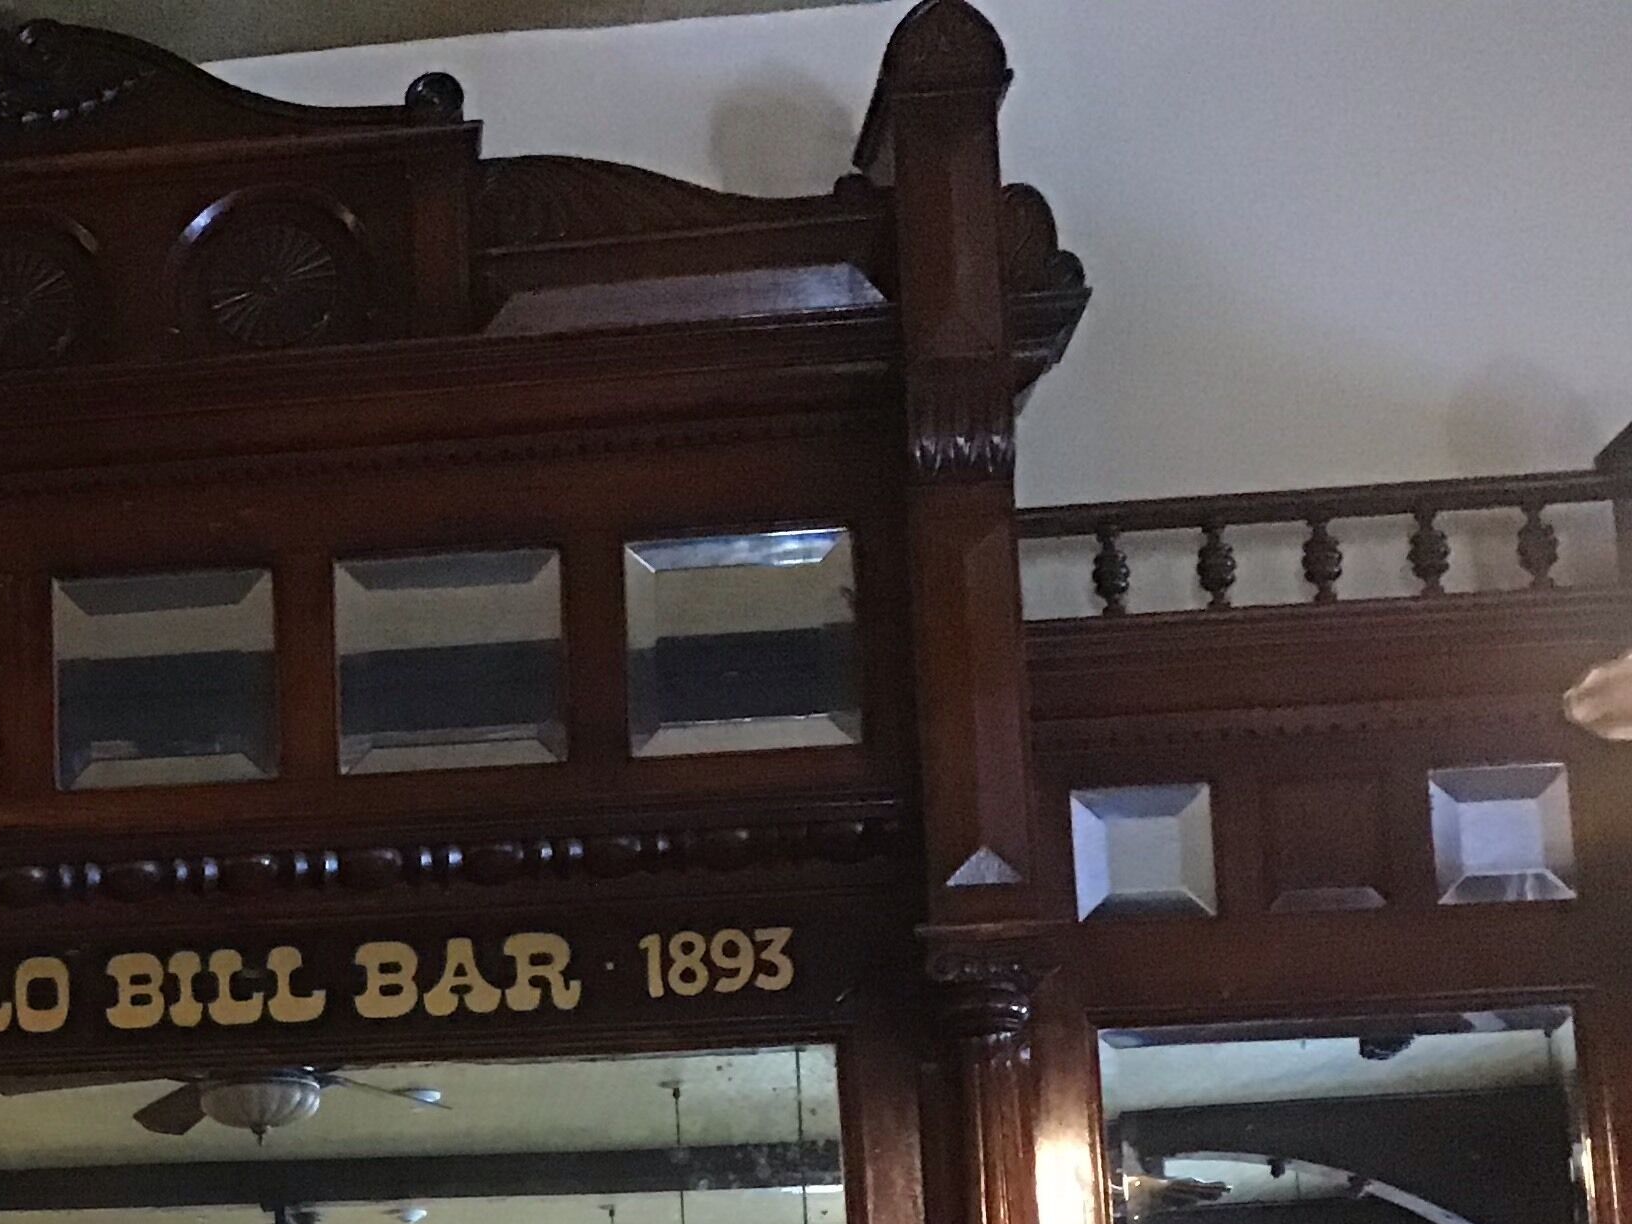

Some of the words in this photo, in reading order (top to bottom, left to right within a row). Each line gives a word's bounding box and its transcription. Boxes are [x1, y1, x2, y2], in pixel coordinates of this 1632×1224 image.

[106, 946, 326, 1028] BILL
[354, 932, 582, 1019] BAR
[639, 927, 794, 998] 1893
